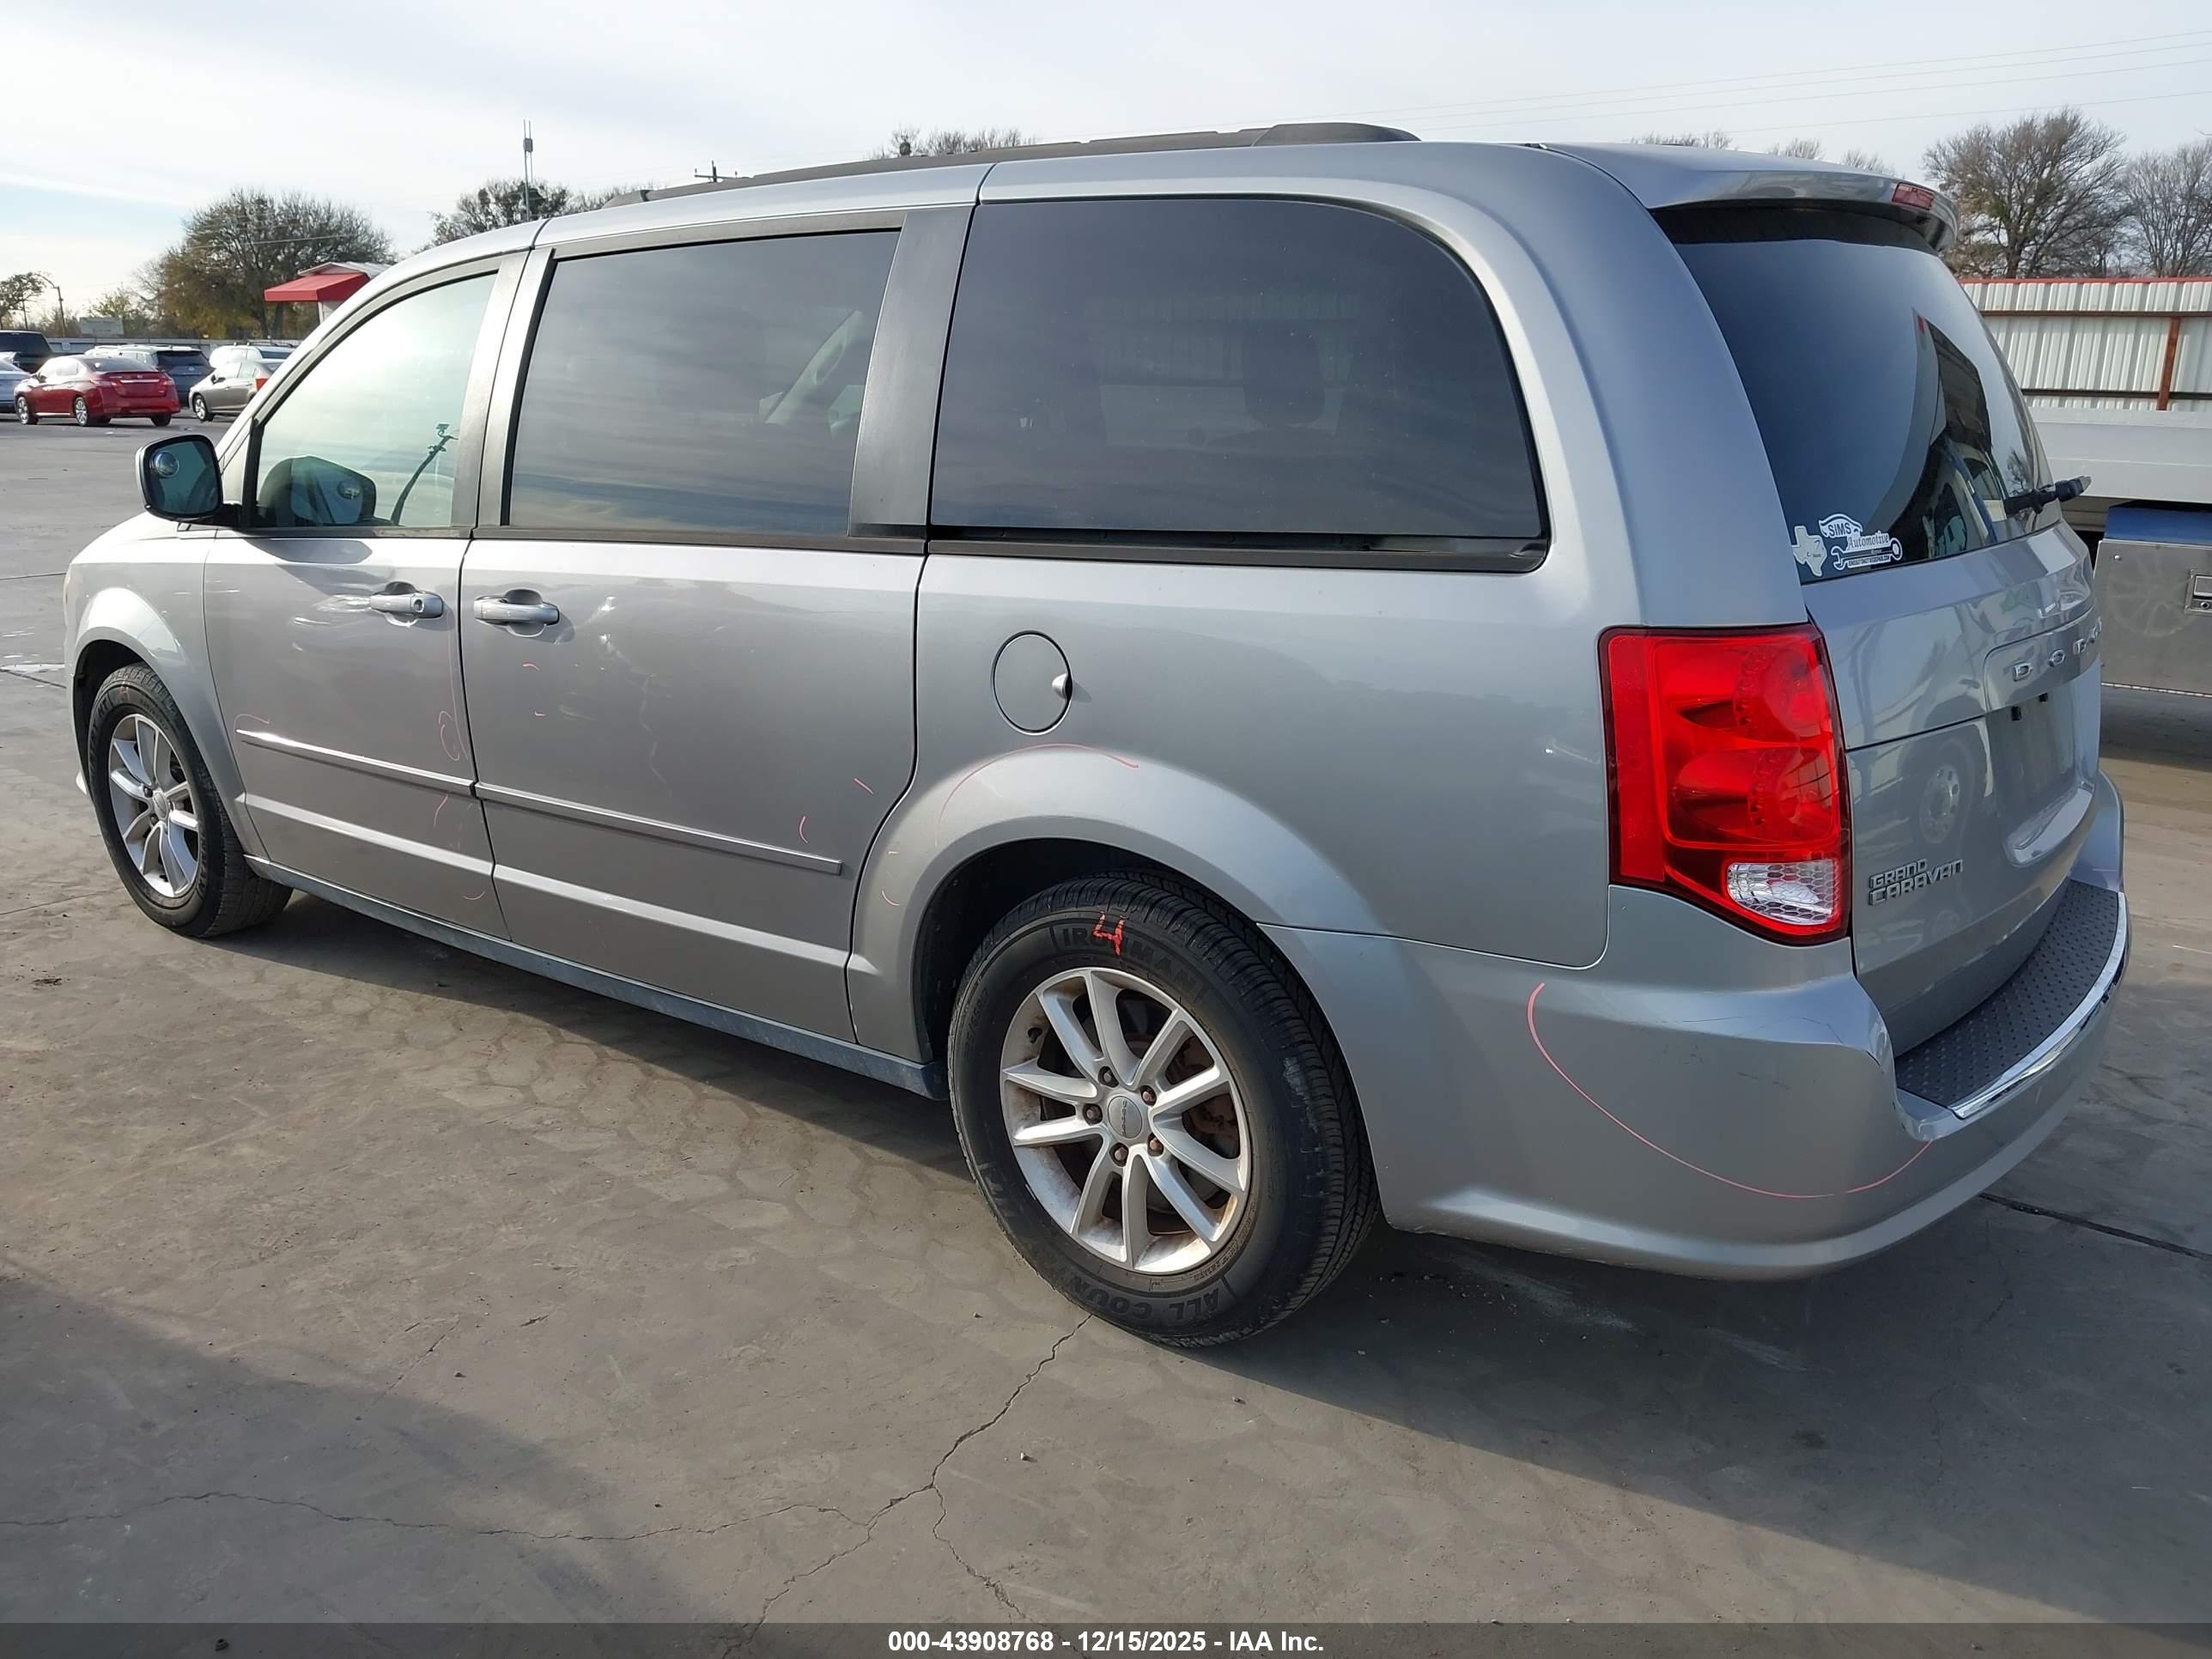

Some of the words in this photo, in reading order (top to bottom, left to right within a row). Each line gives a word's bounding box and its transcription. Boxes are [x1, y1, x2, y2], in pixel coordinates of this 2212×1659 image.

[1827, 522, 1852, 537] SIMS
[1848, 531, 1890, 550] Automotive
[2012, 617, 2102, 683] DOD
[1869, 858, 1928, 889] GRAND
[1869, 860, 1964, 906] CARAVAN
[1091, 911, 1127, 956] 4
[1169, 1288, 1220, 1321] ALL
